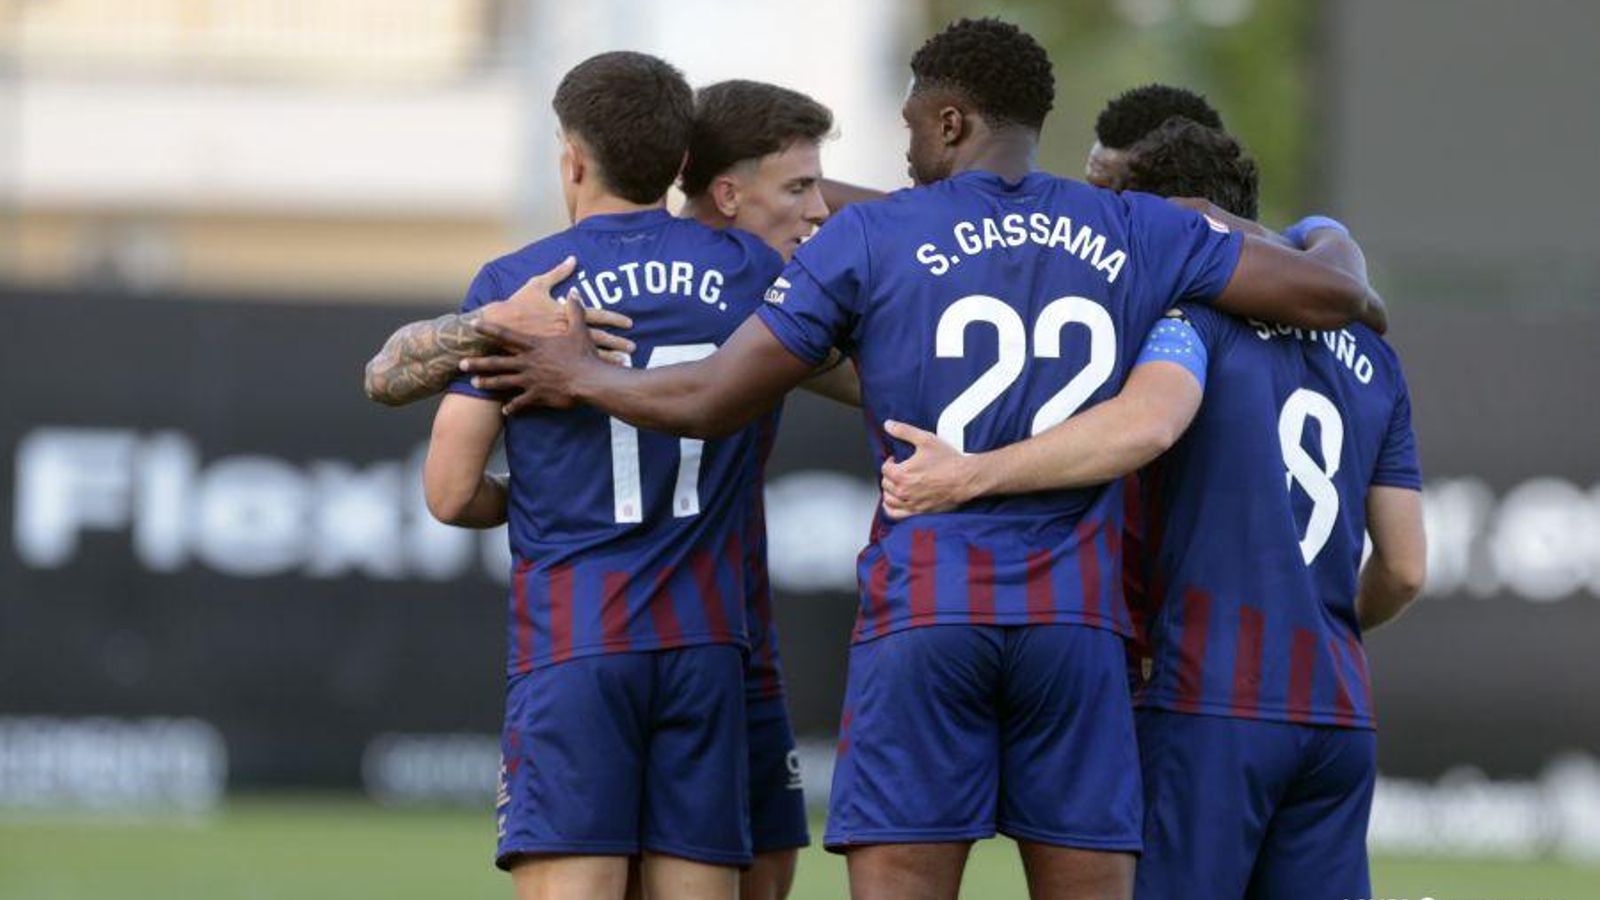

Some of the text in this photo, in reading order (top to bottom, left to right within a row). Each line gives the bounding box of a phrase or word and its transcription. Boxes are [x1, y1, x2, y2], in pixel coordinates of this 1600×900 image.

[916, 212, 1127, 283] S. GASSAMA
[698, 269, 728, 311] G.
[935, 294, 1117, 454] 22
